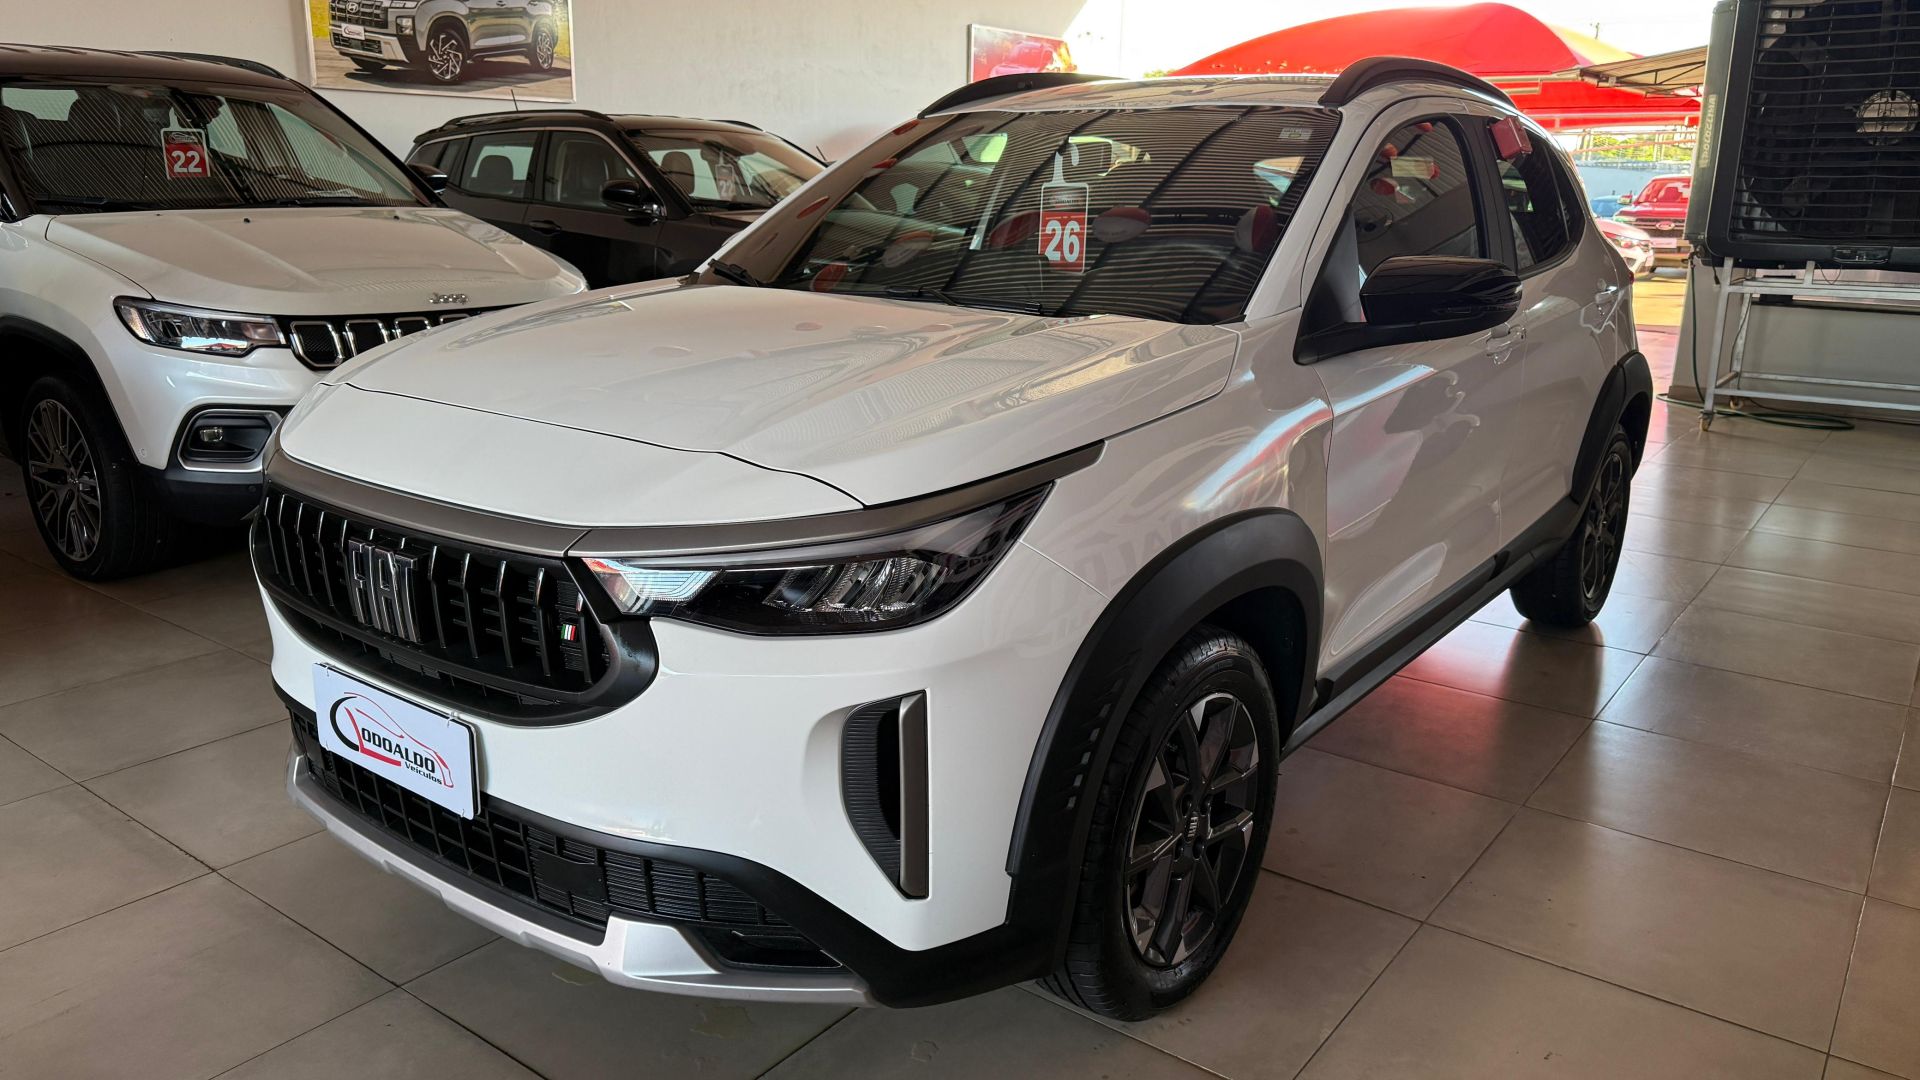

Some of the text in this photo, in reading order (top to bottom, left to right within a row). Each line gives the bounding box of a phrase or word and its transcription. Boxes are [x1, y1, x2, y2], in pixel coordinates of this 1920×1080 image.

[171, 150, 202, 173] 22
[1044, 220, 1080, 262] 26
[429, 292, 468, 305] Jeep
[348, 540, 418, 644] FIAT
